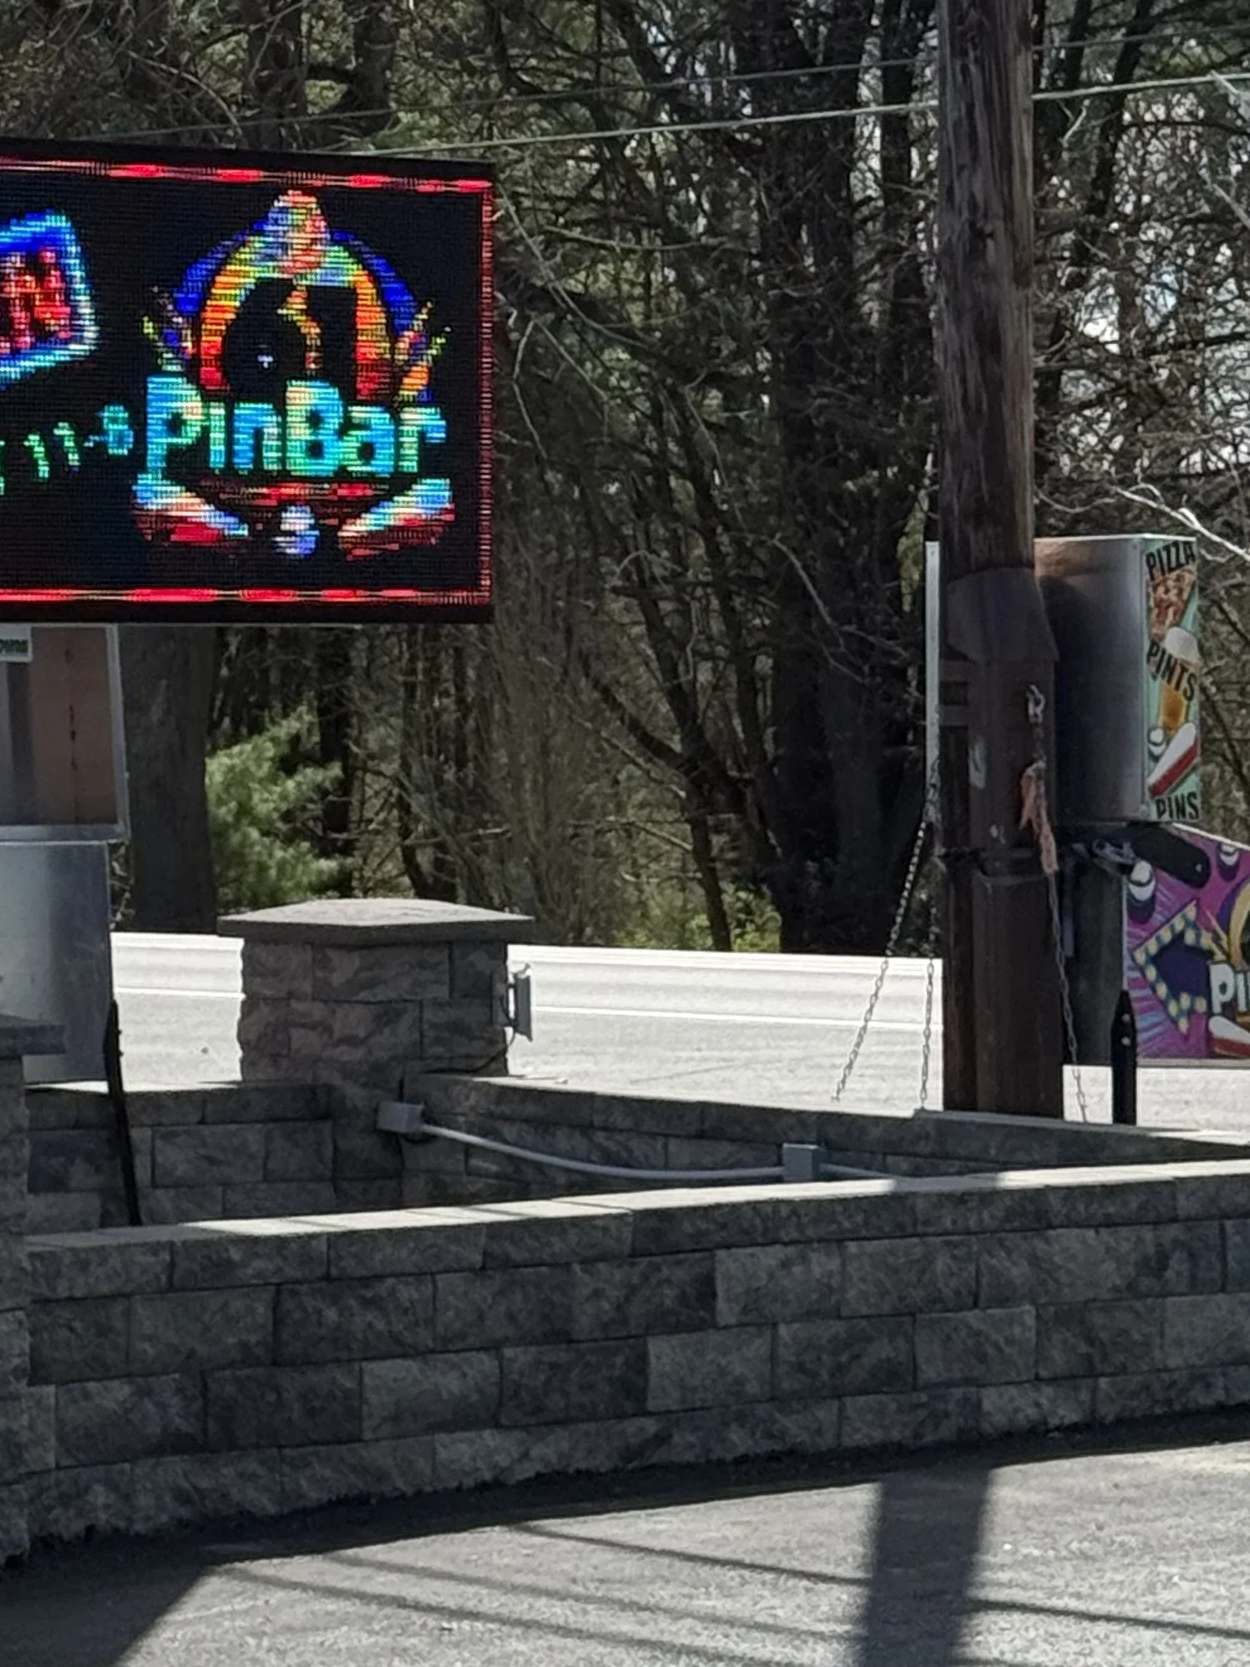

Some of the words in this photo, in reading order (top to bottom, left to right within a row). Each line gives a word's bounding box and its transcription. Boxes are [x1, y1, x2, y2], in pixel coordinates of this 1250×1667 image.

[1146, 539, 1197, 582] PIZZA
[1146, 637, 1198, 704] PINTS
[1155, 791, 1199, 821] PINS
